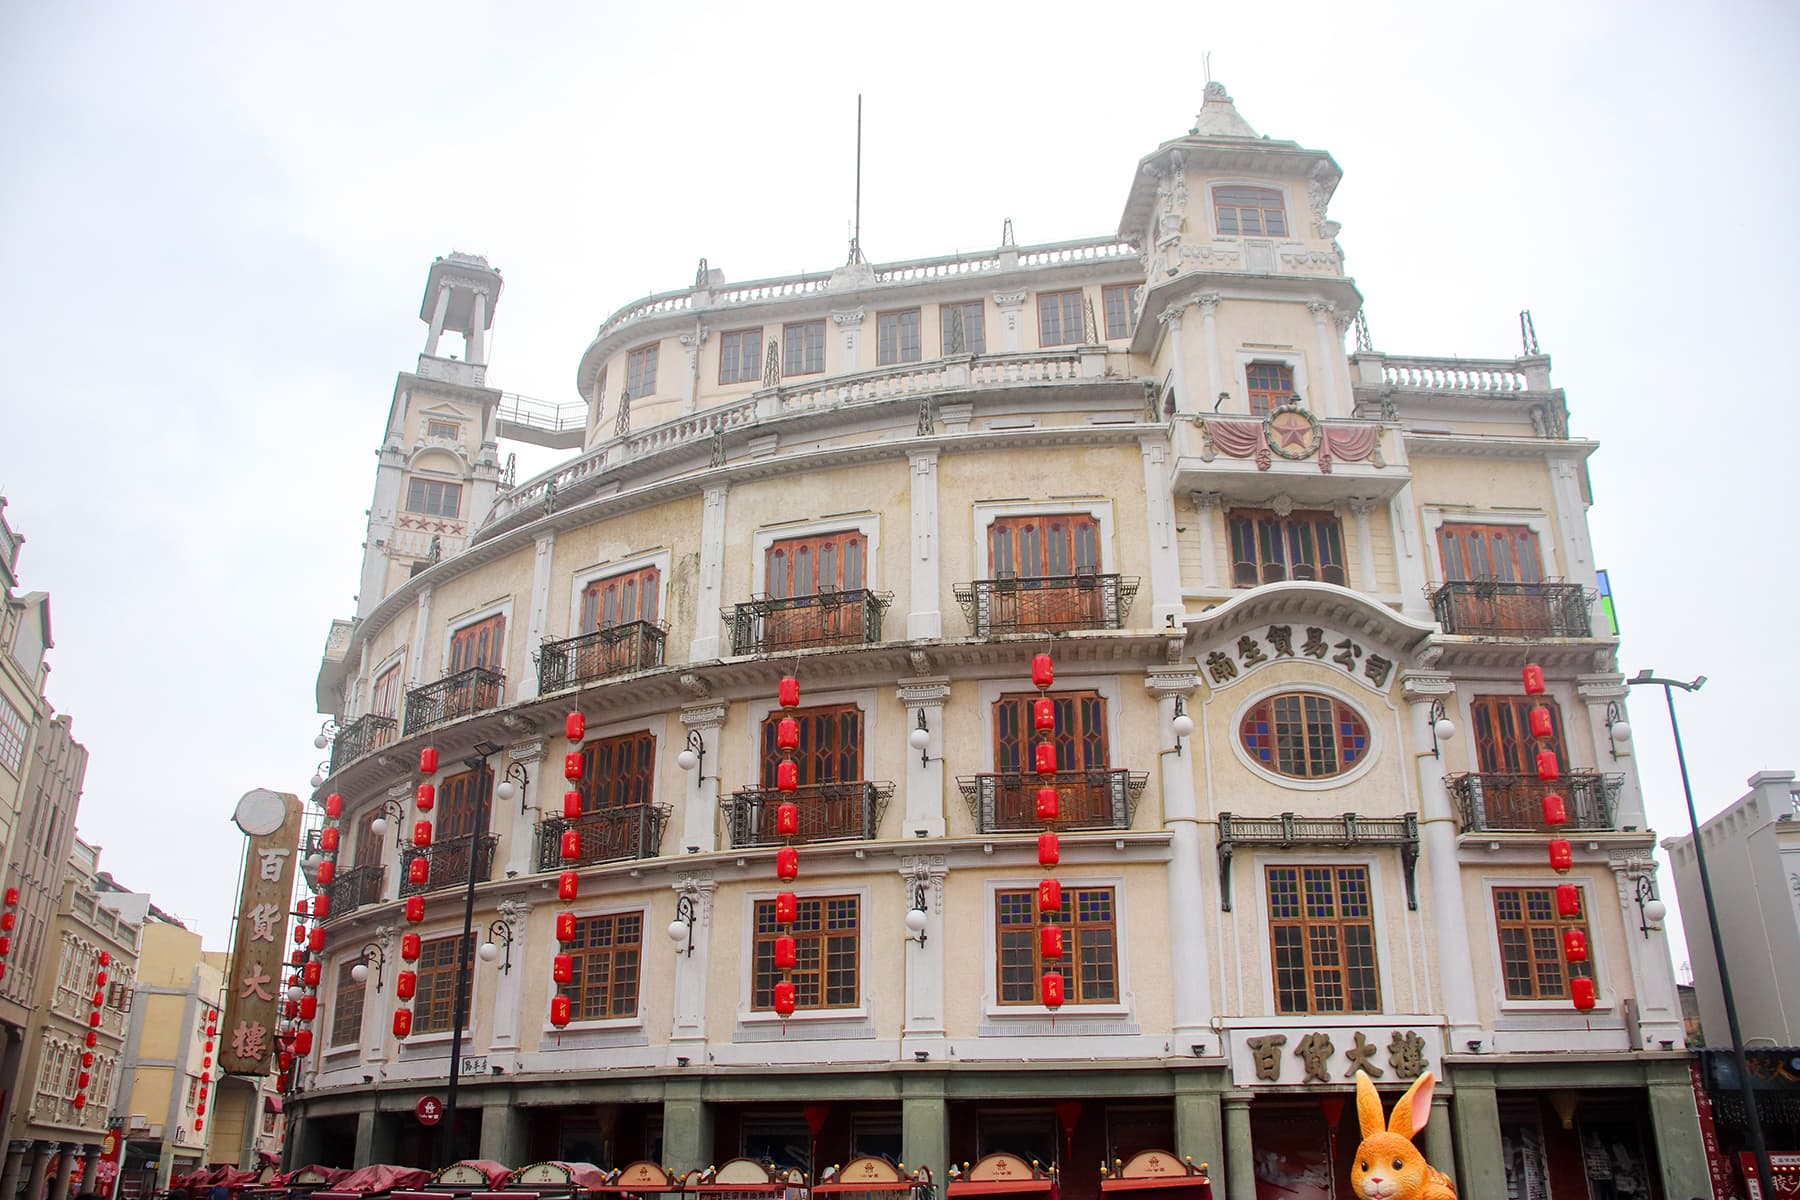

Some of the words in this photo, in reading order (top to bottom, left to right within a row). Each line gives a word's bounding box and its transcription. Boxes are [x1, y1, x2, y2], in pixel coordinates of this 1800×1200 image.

[231, 847, 290, 1061] 百貨大樓
[1246, 1030, 1429, 1083] 百貨大樓
